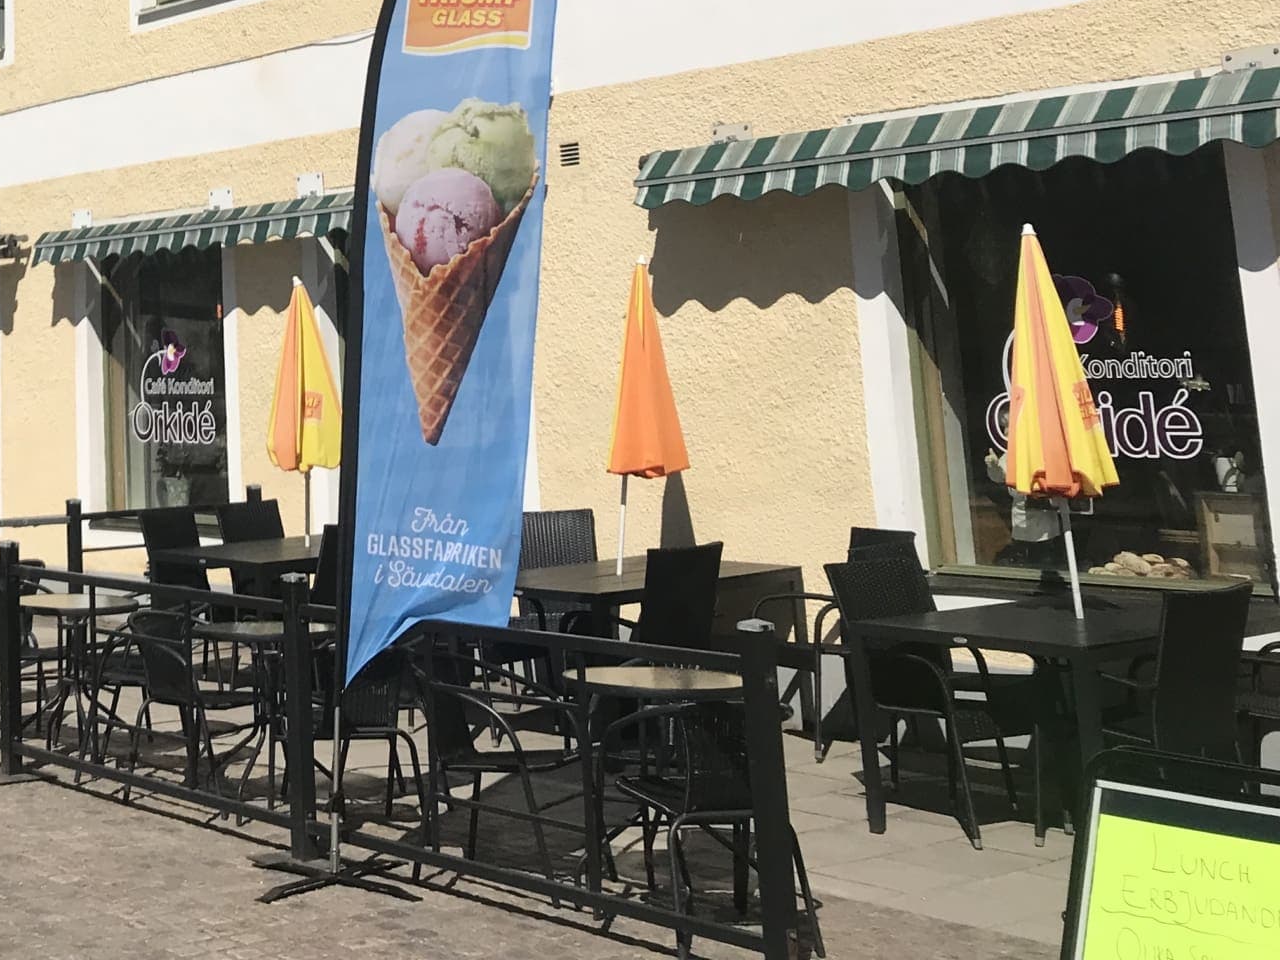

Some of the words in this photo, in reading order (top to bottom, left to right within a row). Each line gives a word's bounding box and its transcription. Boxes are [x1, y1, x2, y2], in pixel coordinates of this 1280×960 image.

[431, 8, 504, 28] GLASS
[144, 377, 166, 395] Café
[167, 376, 215, 395] Konditori
[132, 400, 217, 444] Orkidé
[411, 506, 470, 537] Från
[367, 533, 502, 569] GLASSFABRIKEN
[373, 563, 385, 585] i
[388, 559, 493, 594] Sävdalen
[1151, 831, 1252, 884] LUNCH
